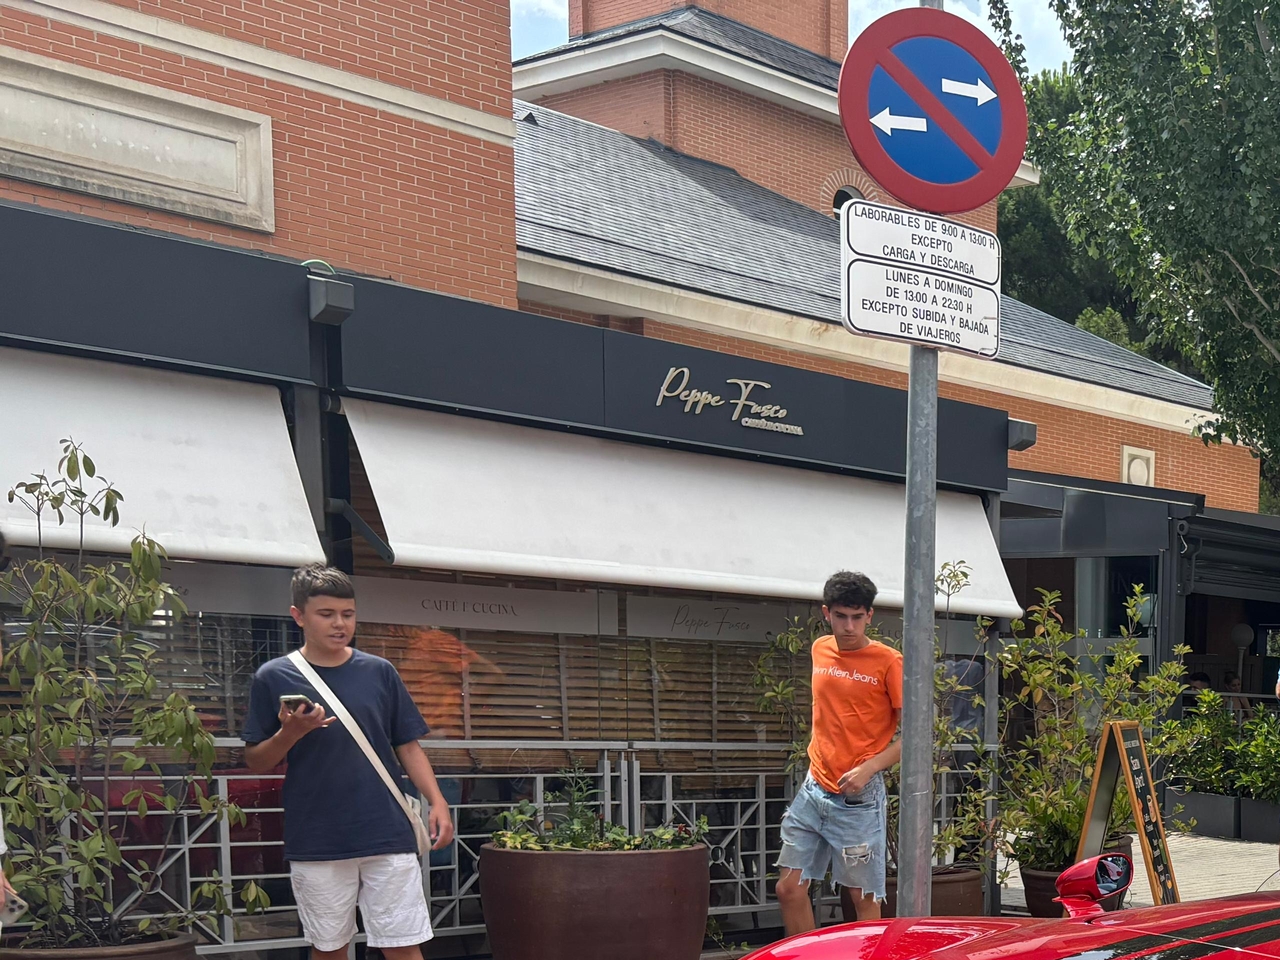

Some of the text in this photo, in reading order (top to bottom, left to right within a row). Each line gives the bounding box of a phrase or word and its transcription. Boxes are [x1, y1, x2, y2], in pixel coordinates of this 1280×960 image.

[855, 205, 995, 250] LABORABLES DE 9:00 A 13:00 H
[911, 233, 953, 253] EXCEPTO
[882, 244, 975, 276] CARGA Y DESCARGA
[885, 269, 973, 299] LUNES A DOMINGO
[886, 286, 973, 314] DE 13:00 A 22:30 H
[861, 298, 989, 336] EXCEPTO SUBIDA Y BAJADA
[900, 321, 961, 344] DE VIAJEROS
[656, 367, 788, 421] Peppe Fusco
[472, 602, 518, 616] CUCINA
[671, 604, 750, 636] Peppe Fusco
[828, 665, 849, 679] Klein
[849, 669, 878, 686] Jeans
